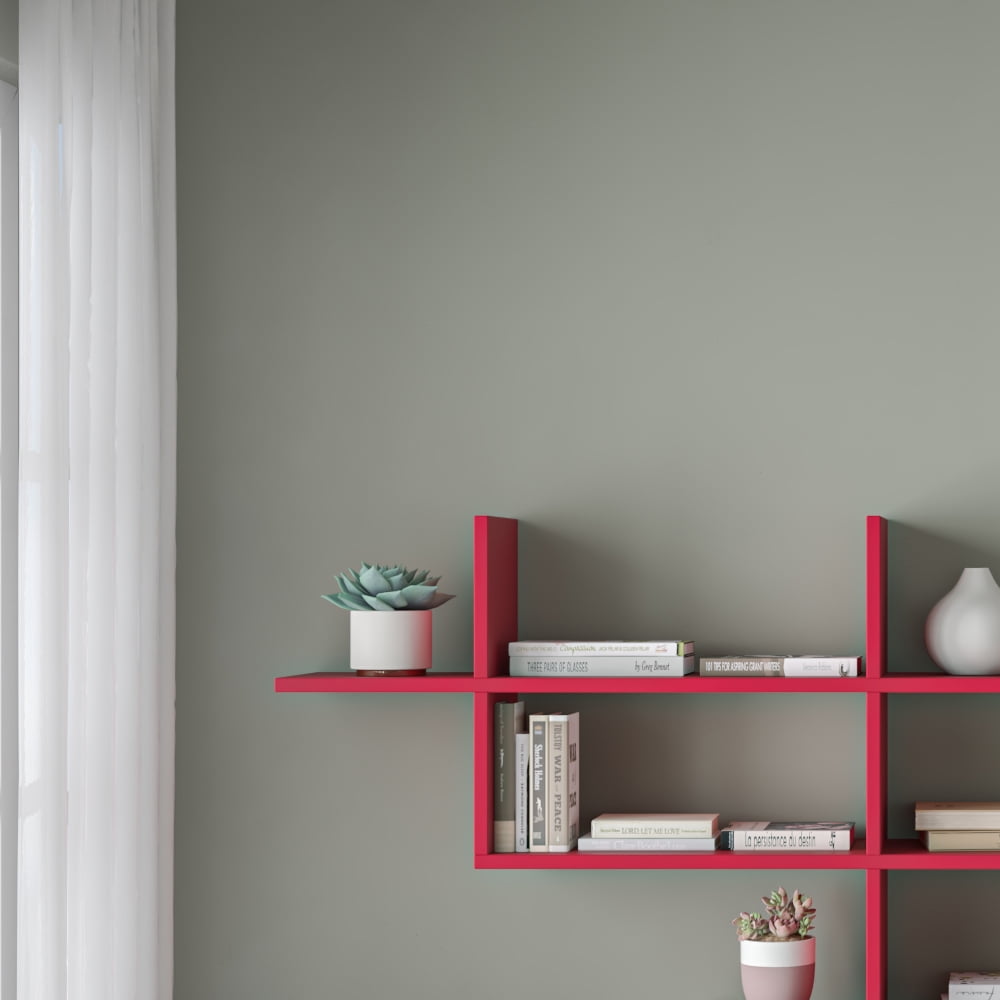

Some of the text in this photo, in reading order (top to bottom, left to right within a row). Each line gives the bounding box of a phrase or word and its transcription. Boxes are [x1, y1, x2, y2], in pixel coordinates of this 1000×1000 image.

[527, 661, 589, 672] THREE PAIRS OF GLASSES
[634, 660, 641, 672] by
[641, 660, 653, 673] Greg
[705, 661, 781, 672] 101 TIPS FOR ASPIRING GRANT WRITERS
[534, 743, 543, 791] Sherlock Holmes
[553, 724, 562, 832] TOLSTOY WAR PEACE
[640, 827, 652, 835] LET
[654, 827, 663, 835] ME
[664, 827, 680, 835] LOVE
[744, 832, 752, 847] La
[753, 832, 787, 850] persistance
[789, 832, 797, 847] du
[798, 832, 816, 847] destin
